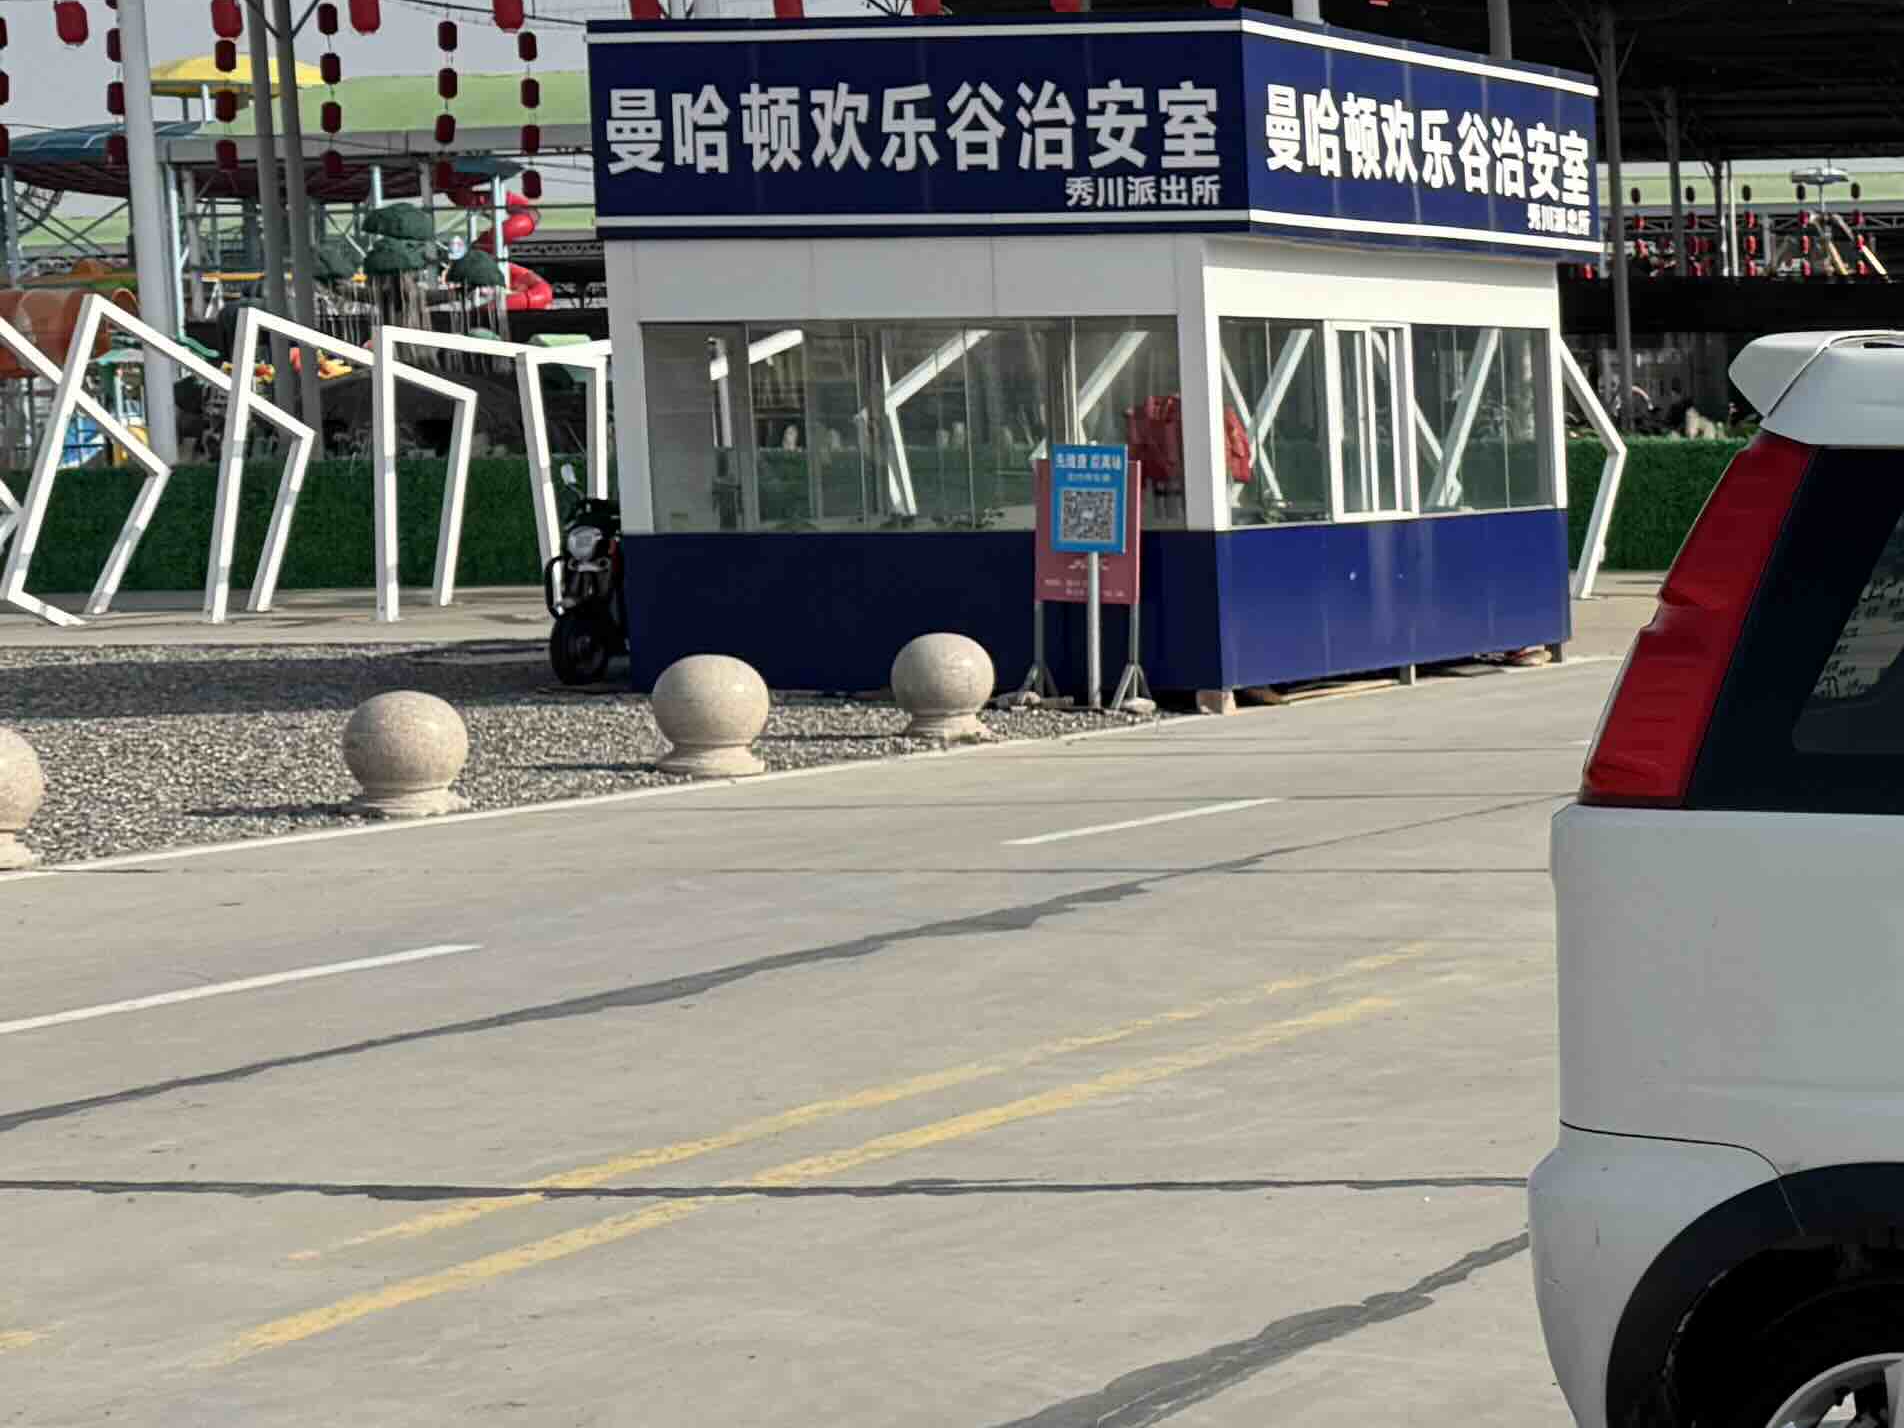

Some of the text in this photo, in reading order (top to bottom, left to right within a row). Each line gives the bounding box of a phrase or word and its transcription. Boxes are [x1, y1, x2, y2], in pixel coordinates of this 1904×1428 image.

[606, 78, 1220, 174] 曼哈顿欢乐谷治安室
[1264, 83, 1591, 206] 曼哈顿欢乐谷治安室
[1065, 174, 1220, 207] 秀川派出所
